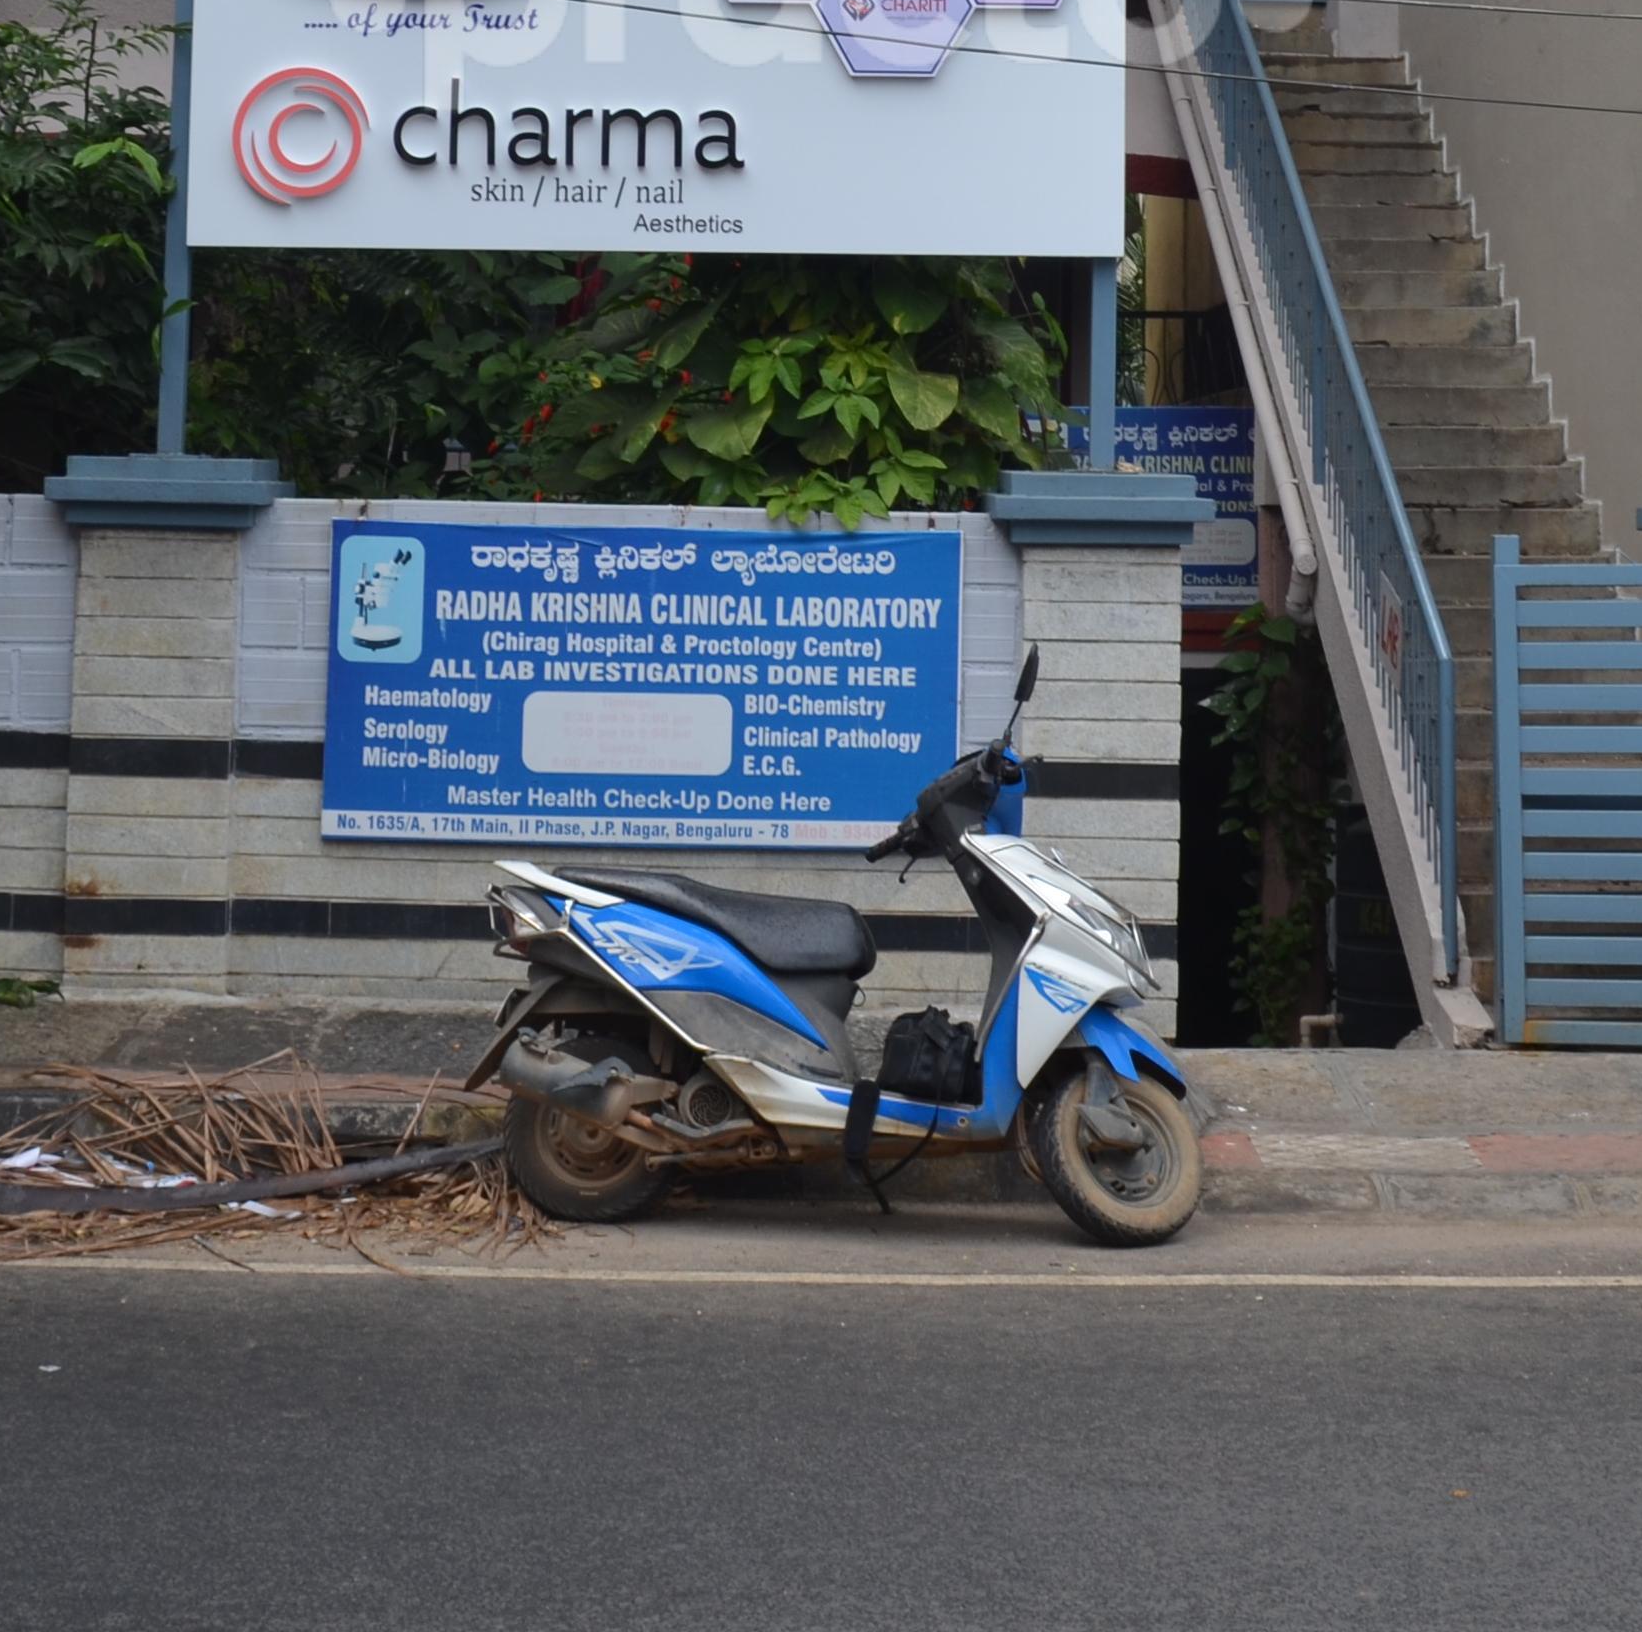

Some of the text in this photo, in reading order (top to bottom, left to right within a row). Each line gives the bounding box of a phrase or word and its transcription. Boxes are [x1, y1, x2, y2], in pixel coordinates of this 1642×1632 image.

[347, 5, 379, 33] of
[384, 8, 452, 36] your
[462, 2, 538, 35] Trust
[393, 77, 745, 172] charma
[470, 174, 525, 205] skin
[554, 174, 609, 205] hair
[635, 176, 684, 205] nail
[633, 212, 744, 234] Aesthetics
[436, 590, 942, 630] RADHA KRISHNA CLINICAL LABORATORY
[482, 631, 883, 662] (Chirag Hospital & Proctology Centre)
[430, 659, 917, 688] ALL LAB INVESTIGATIONS DONE HERE
[364, 685, 492, 713] Haematology
[744, 695, 886, 720] BIO-Chemistry
[364, 717, 448, 744] Serology
[744, 726, 922, 754] Clinical Pathology
[362, 747, 499, 774] Micro-Biology
[743, 755, 802, 777] E.C.G.
[447, 784, 831, 814] Master Health Check-Up Done Here
[337, 813, 360, 831] No.
[431, 815, 466, 834] 17th
[469, 816, 512, 837] Main,
[534, 818, 586, 839] Phase,
[591, 819, 618, 838] J.P.
[623, 820, 670, 841] Nagar,
[676, 821, 752, 842] Bengaluru
[771, 823, 790, 839] 78
